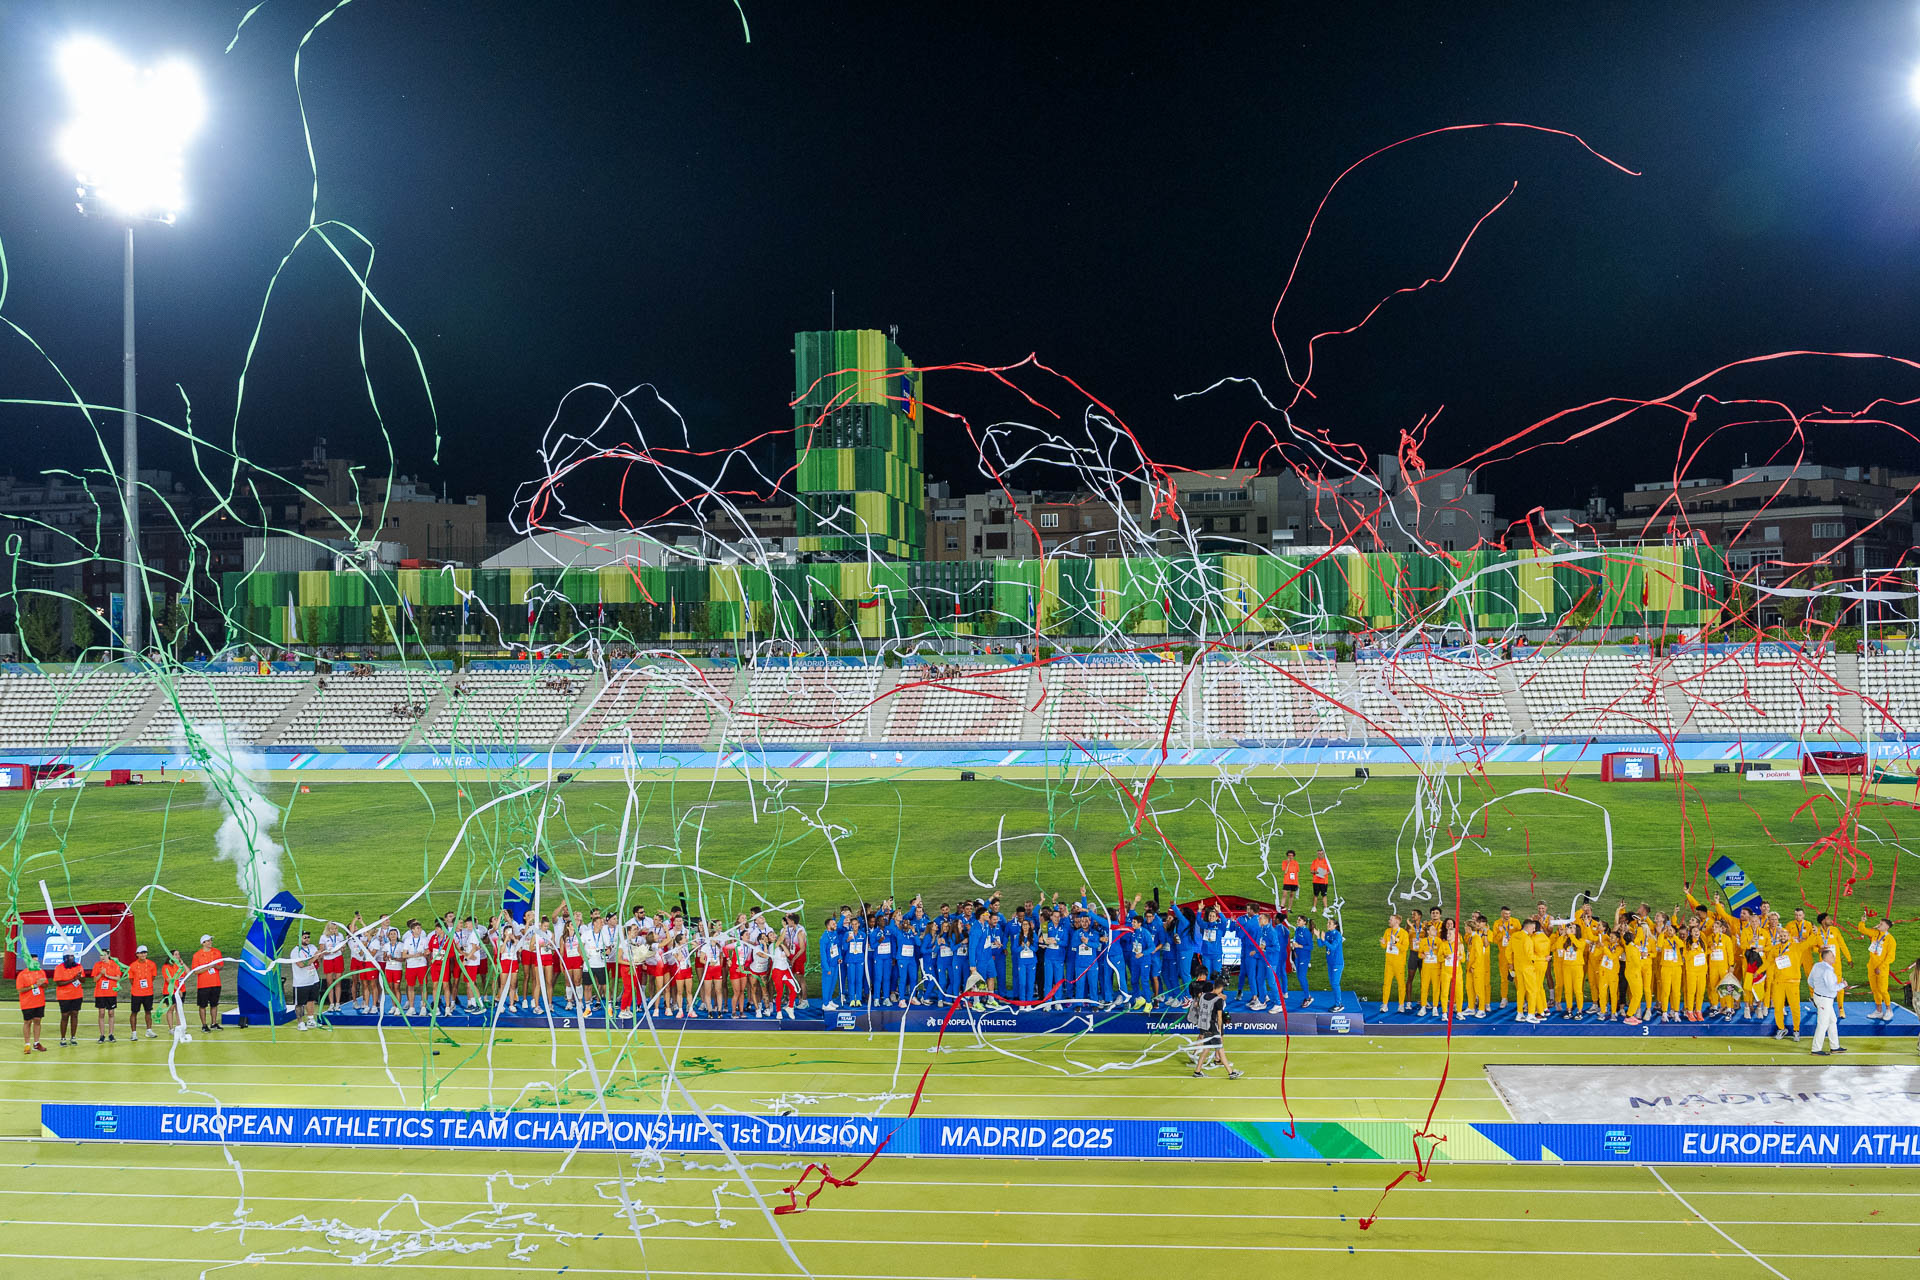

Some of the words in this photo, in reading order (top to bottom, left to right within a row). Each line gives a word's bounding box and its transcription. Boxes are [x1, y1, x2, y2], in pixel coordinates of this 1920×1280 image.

[226, 665, 256, 673] MADRID
[1335, 750, 1372, 761] ITALY
[1878, 745, 1920, 756] ITALY
[563, 1018, 570, 1028] 2
[1146, 1022, 1169, 1030] TEAM
[1243, 1022, 1278, 1031] DIVISION
[1642, 1025, 1650, 1036] 3
[160, 1113, 294, 1136] EUROPEAN
[303, 1116, 434, 1139] ATHLETICS
[440, 1118, 508, 1140] TEAM
[514, 1120, 725, 1144] CHAMPIONSHIPS
[731, 1123, 761, 1144] 1st
[941, 1125, 1047, 1148] MADRID
[1051, 1127, 1115, 1149] 2025
[1682, 1132, 1840, 1156] EUROPEAN
[1851, 1133, 1920, 1156] ATHL
